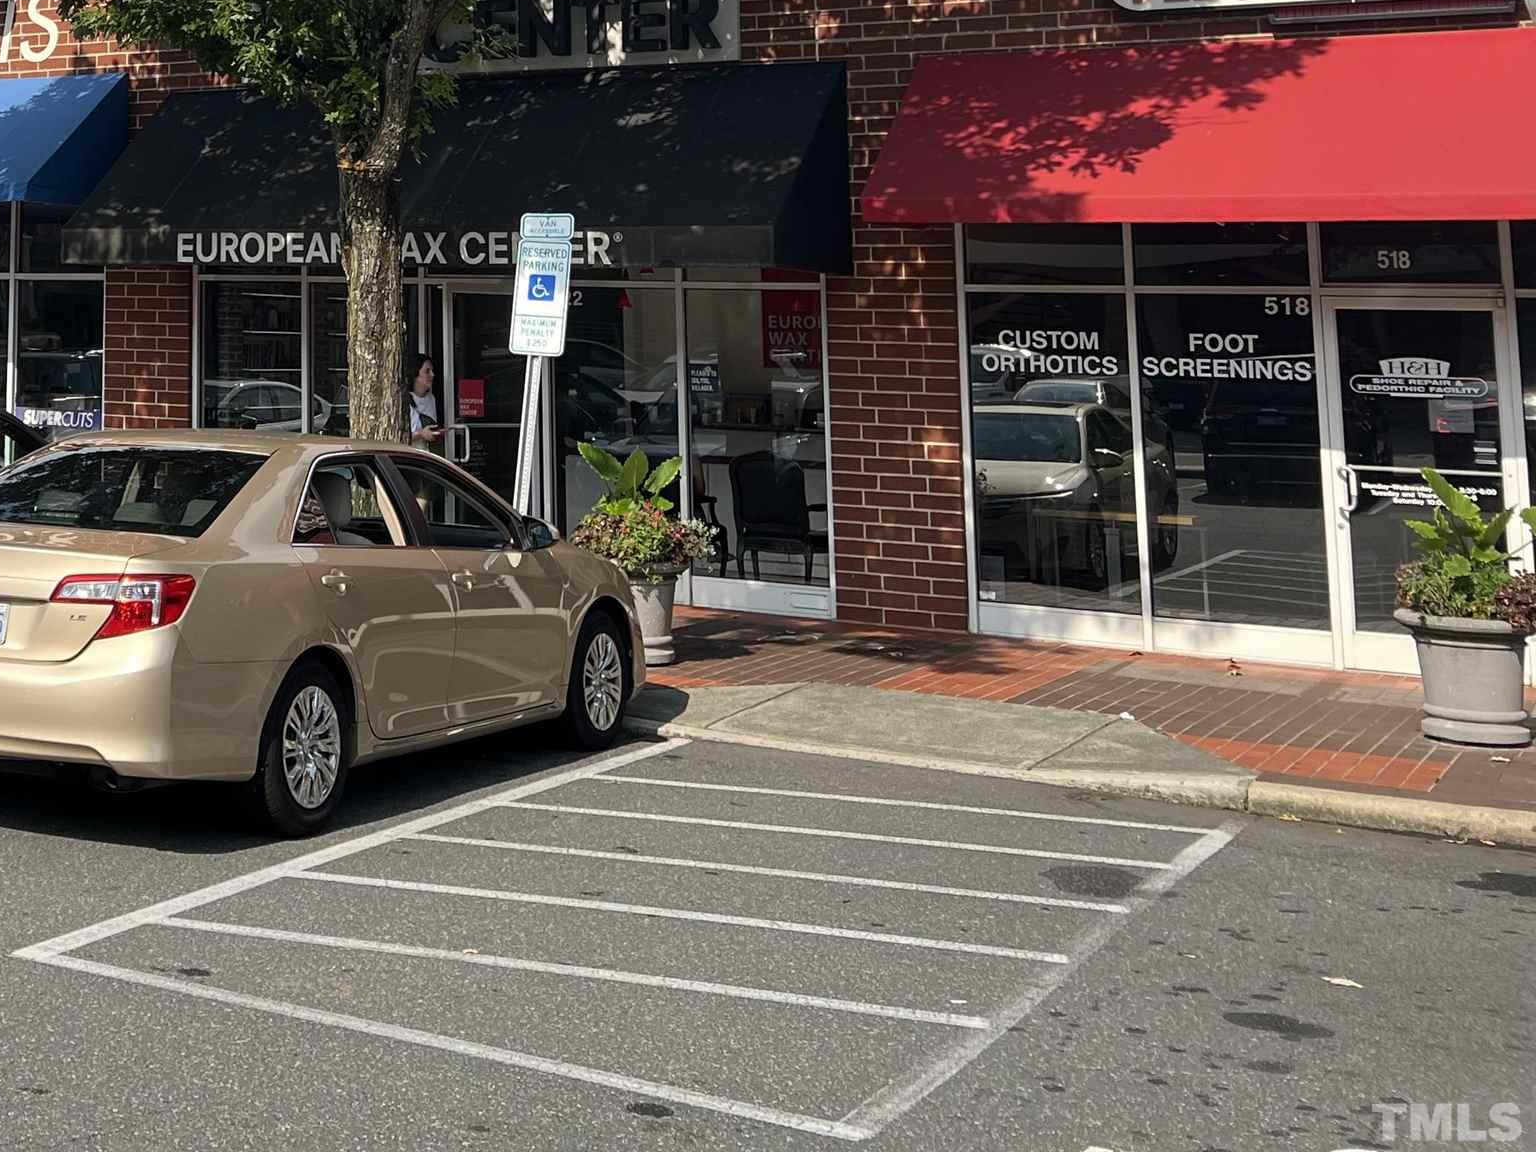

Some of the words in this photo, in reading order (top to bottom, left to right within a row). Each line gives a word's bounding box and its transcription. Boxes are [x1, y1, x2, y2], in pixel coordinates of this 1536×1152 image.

[539, 219, 557, 227] VAN
[401, 232, 448, 264] AX
[522, 247, 568, 259] RESERVED
[522, 260, 564, 273] PARKING
[1377, 250, 1411, 270] 518
[1264, 296, 1310, 316] 518
[768, 331, 808, 345] WAX
[998, 329, 1099, 350] CUSTOM
[1189, 332, 1259, 353] FOOT
[982, 354, 1119, 376] ORTHOTICS
[1143, 356, 1312, 381] SCREENINGS
[1388, 360, 1441, 376] H&H
[1357, 384, 1425, 392] PEDORTHIC
[1429, 386, 1481, 394] FACILITY
[23, 409, 94, 428] SUPERCUTS
